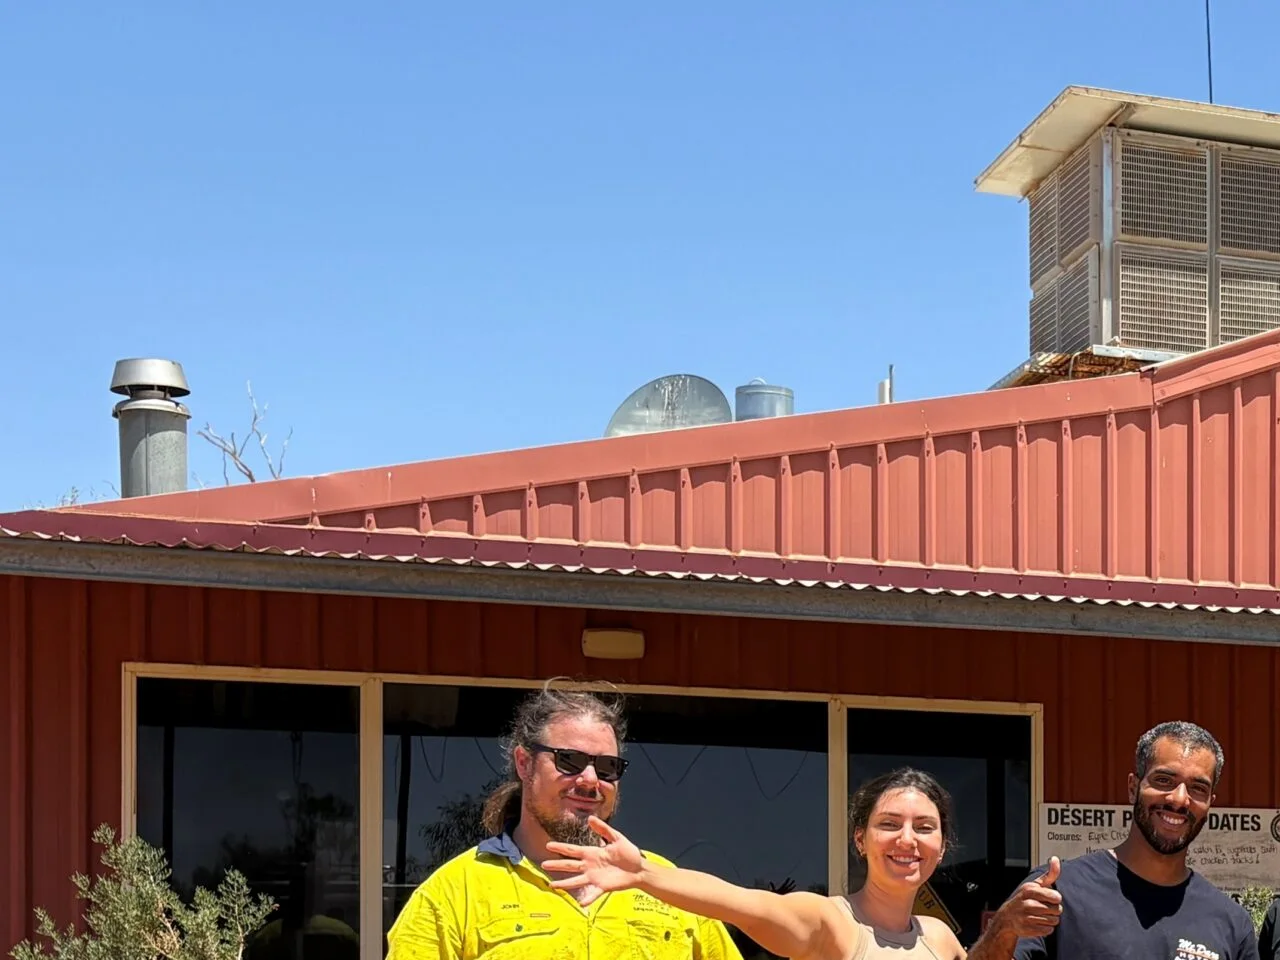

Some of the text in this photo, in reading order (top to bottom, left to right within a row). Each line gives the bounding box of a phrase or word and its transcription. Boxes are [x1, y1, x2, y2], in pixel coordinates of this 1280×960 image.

[1048, 808, 1116, 827] DESERT
[1209, 813, 1261, 831] DATES
[1048, 831, 1082, 841] Closures:
